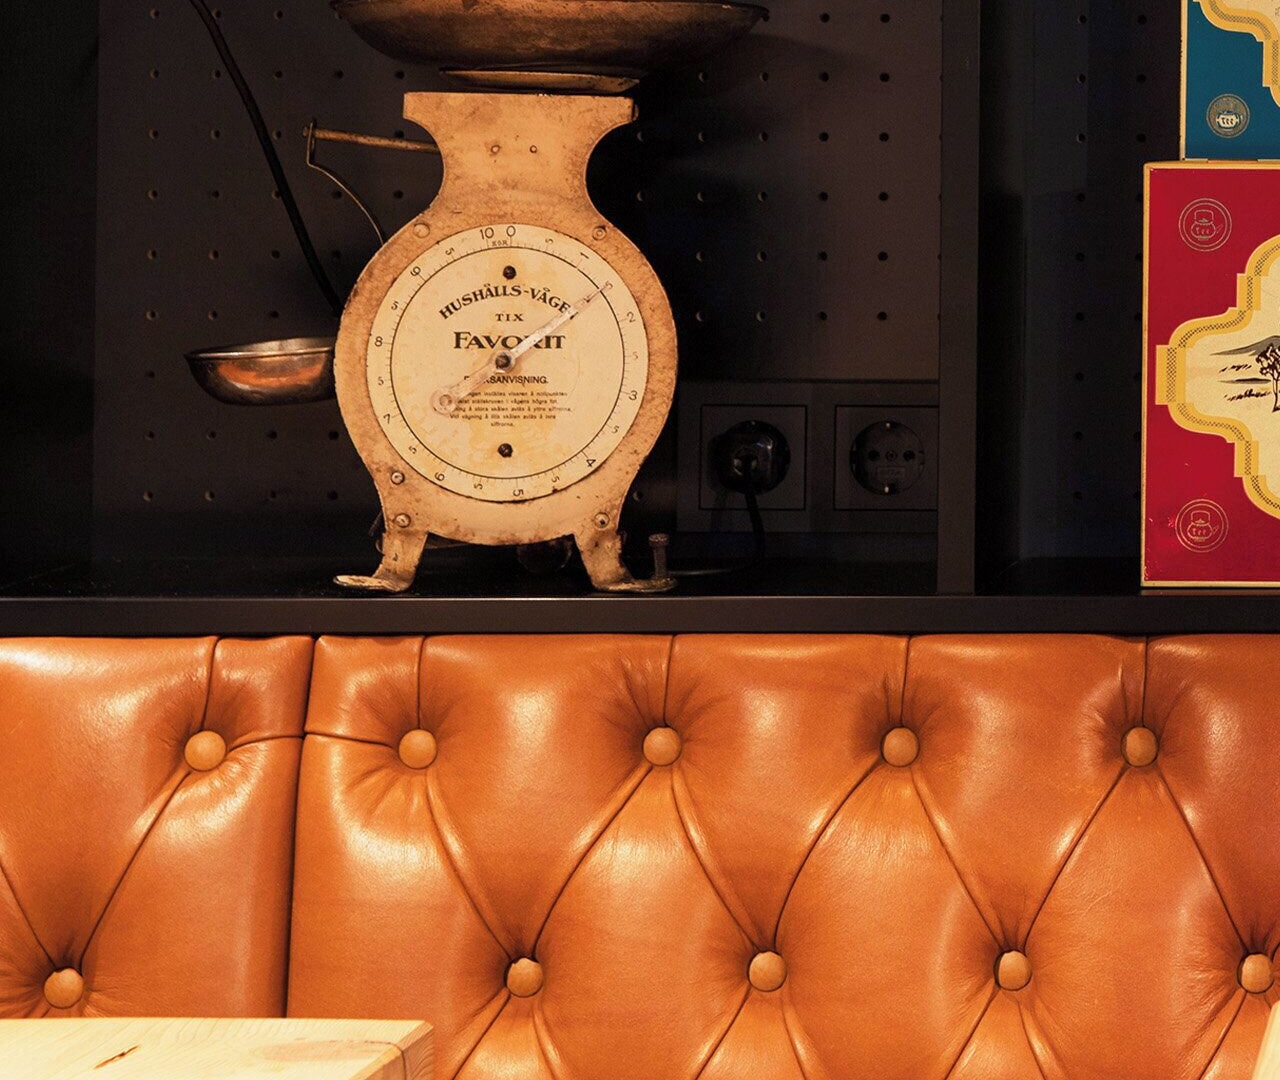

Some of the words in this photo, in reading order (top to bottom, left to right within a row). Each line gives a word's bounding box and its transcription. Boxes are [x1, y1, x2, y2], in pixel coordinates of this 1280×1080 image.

[480, 227, 494, 240] 10
[506, 225, 516, 237] 0
[495, 313, 524, 322] TIX
[626, 311, 636, 323] 2
[374, 336, 383, 347] 8
[628, 390, 637, 401] 3
[383, 413, 391, 424] 7
[585, 457, 597, 468] 4
